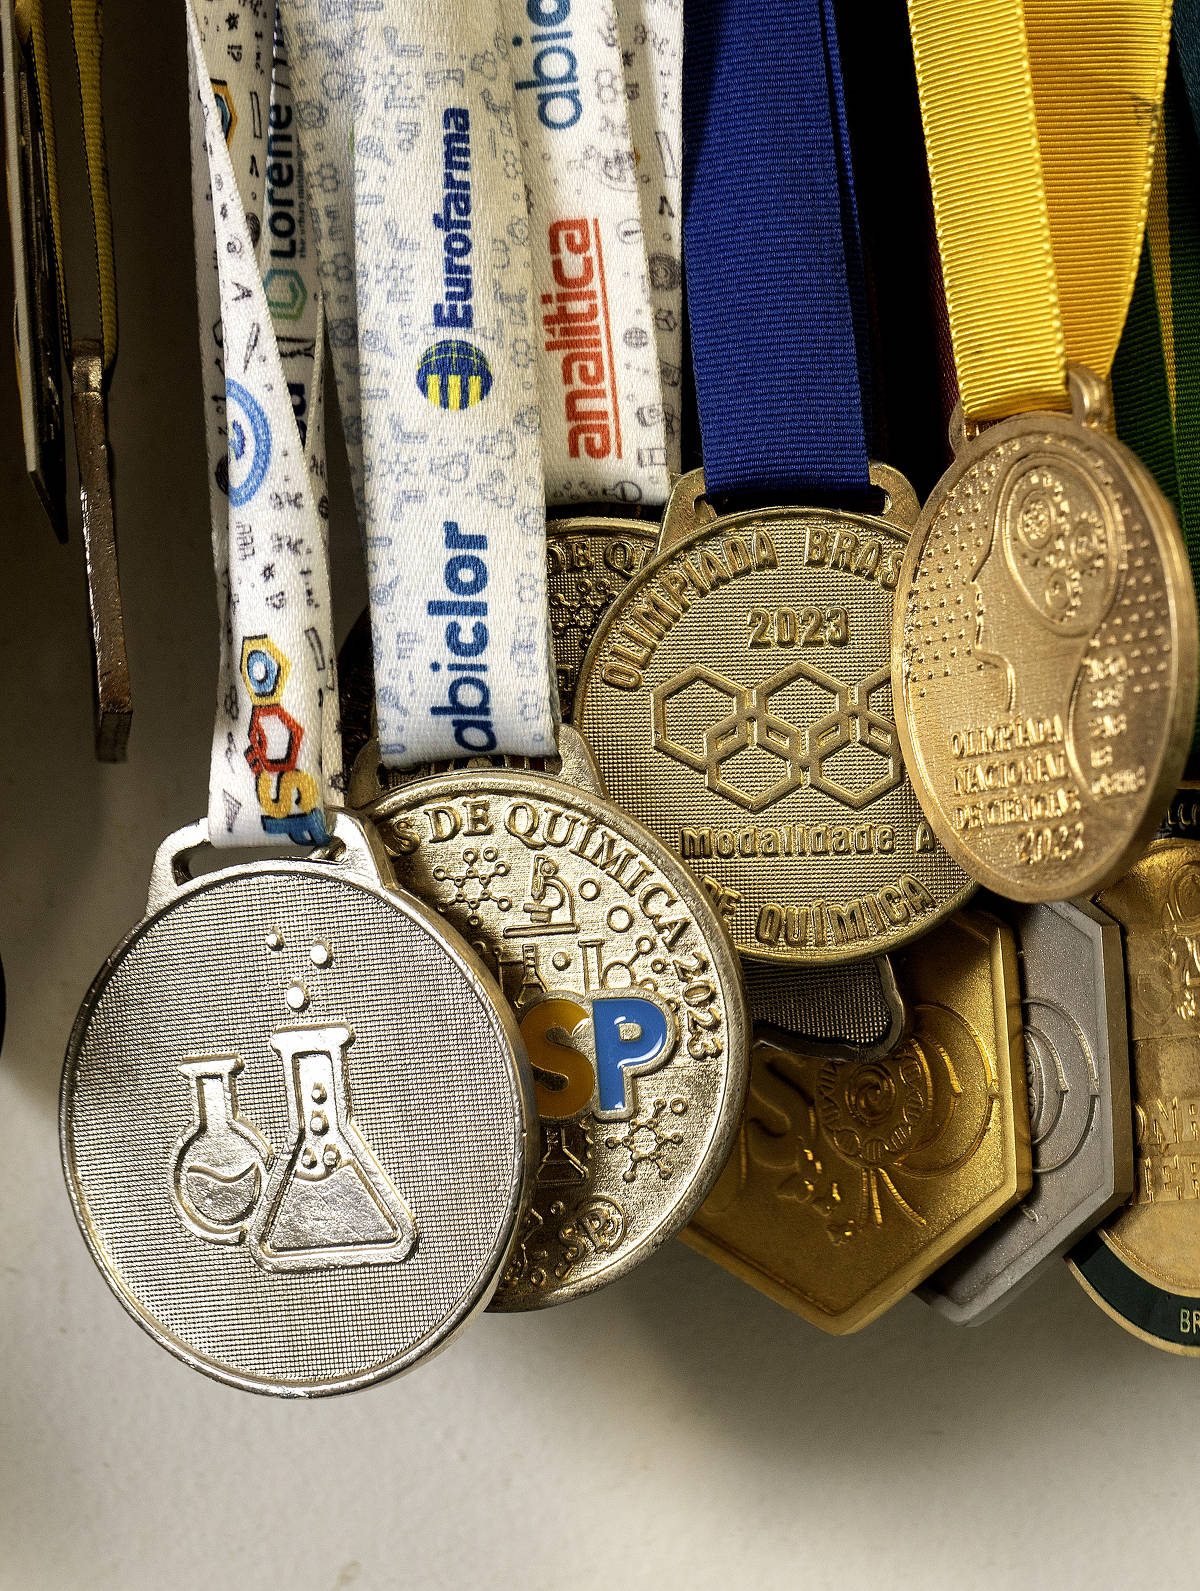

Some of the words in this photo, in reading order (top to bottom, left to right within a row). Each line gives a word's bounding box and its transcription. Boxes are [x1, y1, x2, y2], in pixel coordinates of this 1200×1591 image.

[267, 104, 297, 260] Lorene
[433, 107, 472, 328] Eurofarma
[541, 217, 616, 461] analitica
[428, 521, 497, 753] abiclor
[748, 606, 851, 649] 2023
[427, 801, 493, 843] DE
[671, 951, 722, 1060] 2023
[681, 824, 895, 859] Modalidade
[914, 828, 934, 853] A
